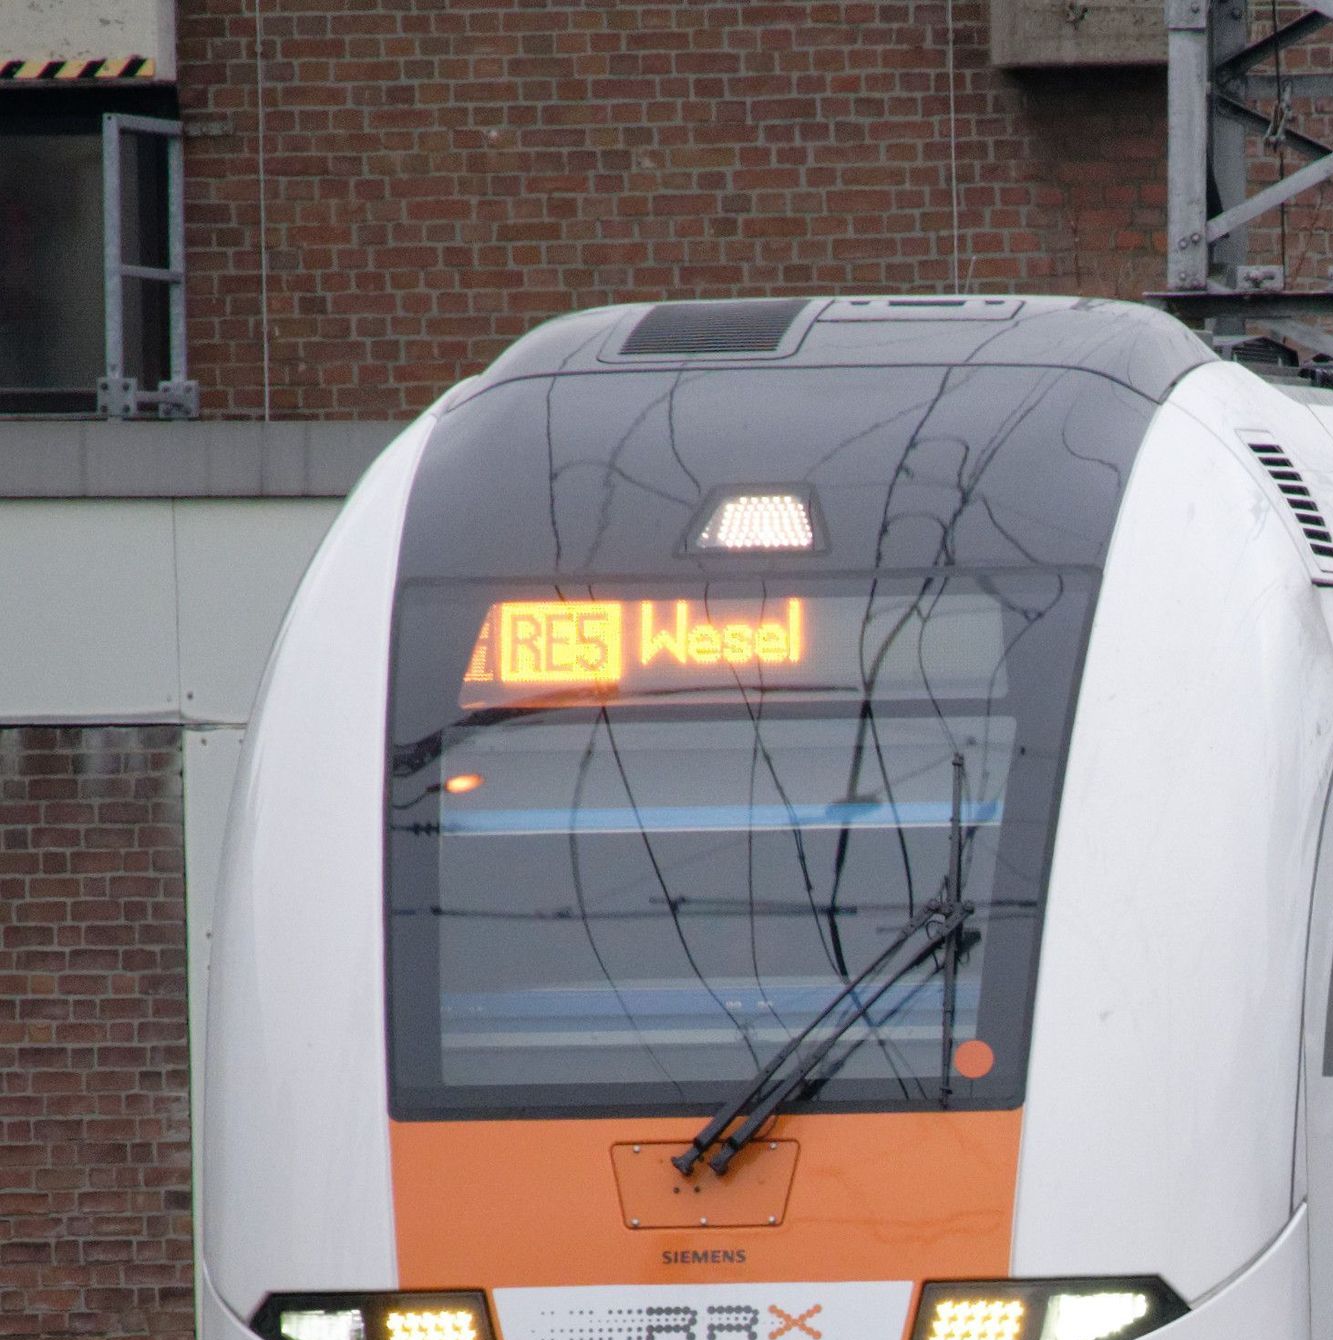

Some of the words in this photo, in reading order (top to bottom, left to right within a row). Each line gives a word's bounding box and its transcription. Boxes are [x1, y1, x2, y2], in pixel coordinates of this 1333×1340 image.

[510, 613, 607, 674] RE5
[640, 597, 803, 665] Wesel
[661, 1248, 747, 1266] SIEMENS
